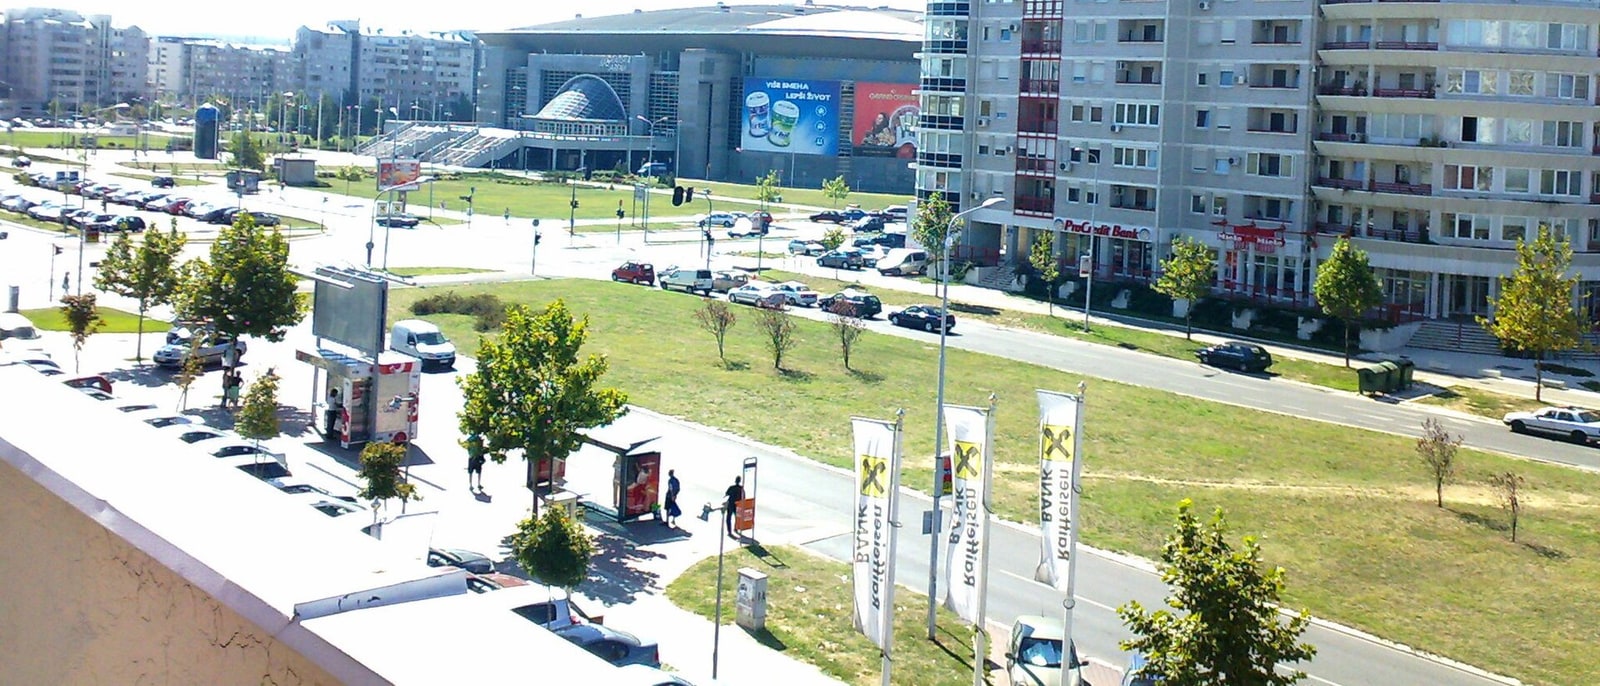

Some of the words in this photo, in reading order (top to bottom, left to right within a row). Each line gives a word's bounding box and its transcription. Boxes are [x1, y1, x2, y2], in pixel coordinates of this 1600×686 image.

[806, 92, 831, 101] ŽIVOT
[1064, 219, 1111, 236] ProCredit
[1112, 224, 1140, 240] Bank
